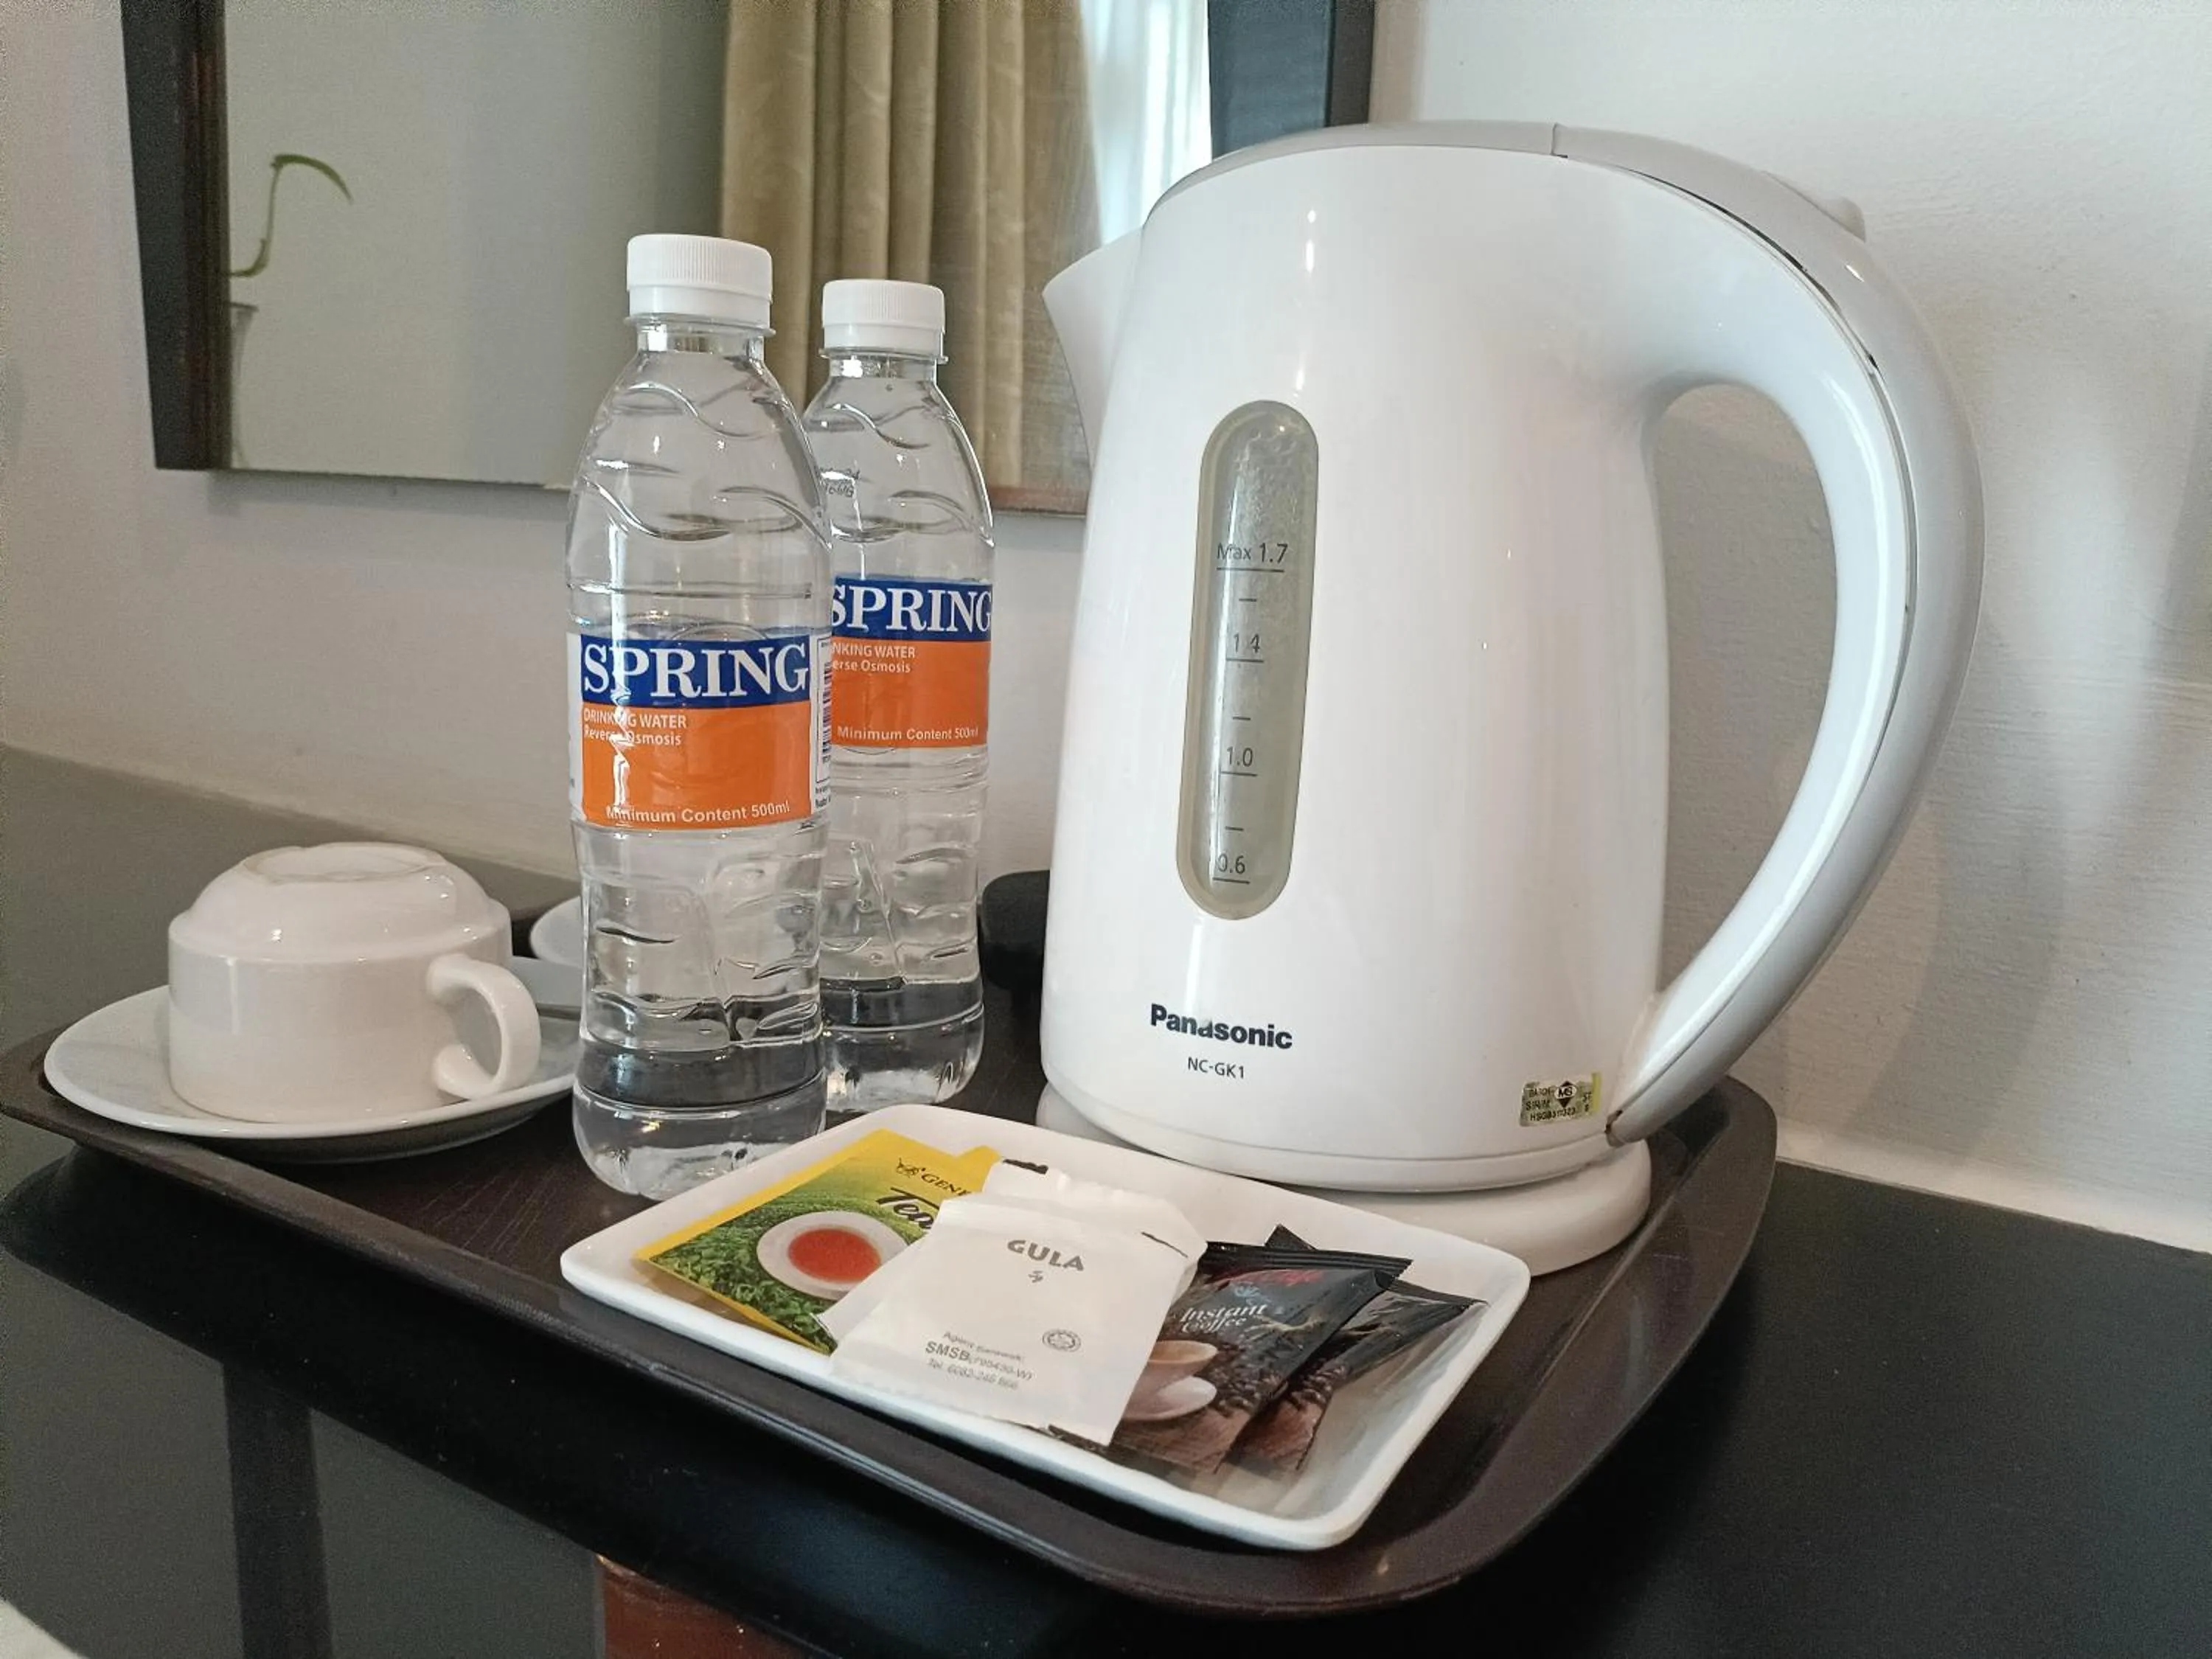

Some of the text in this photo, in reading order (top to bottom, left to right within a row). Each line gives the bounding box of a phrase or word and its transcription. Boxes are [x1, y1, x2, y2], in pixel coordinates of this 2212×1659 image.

[1217, 542, 1288, 563] Max 1.7
[831, 584, 992, 633] SPRING
[832, 642, 872, 657] NKING
[874, 645, 916, 658] WATER
[1233, 633, 1260, 653] 14
[583, 642, 809, 698] SPRING
[860, 659, 911, 673] Osmosis
[583, 708, 687, 729] DRINKG WATER
[627, 731, 682, 746] Osmosis
[838, 726, 902, 740] Minimum
[906, 727, 952, 741] Content
[1227, 747, 1253, 767] 1.0
[605, 801, 790, 823] Minimum Content 500ml
[1217, 853, 1245, 874] 0.6
[1150, 1003, 1293, 1049] Panasonic
[1188, 1056, 1245, 1079] NC-GK1
[1007, 1239, 1085, 1272] GULA
